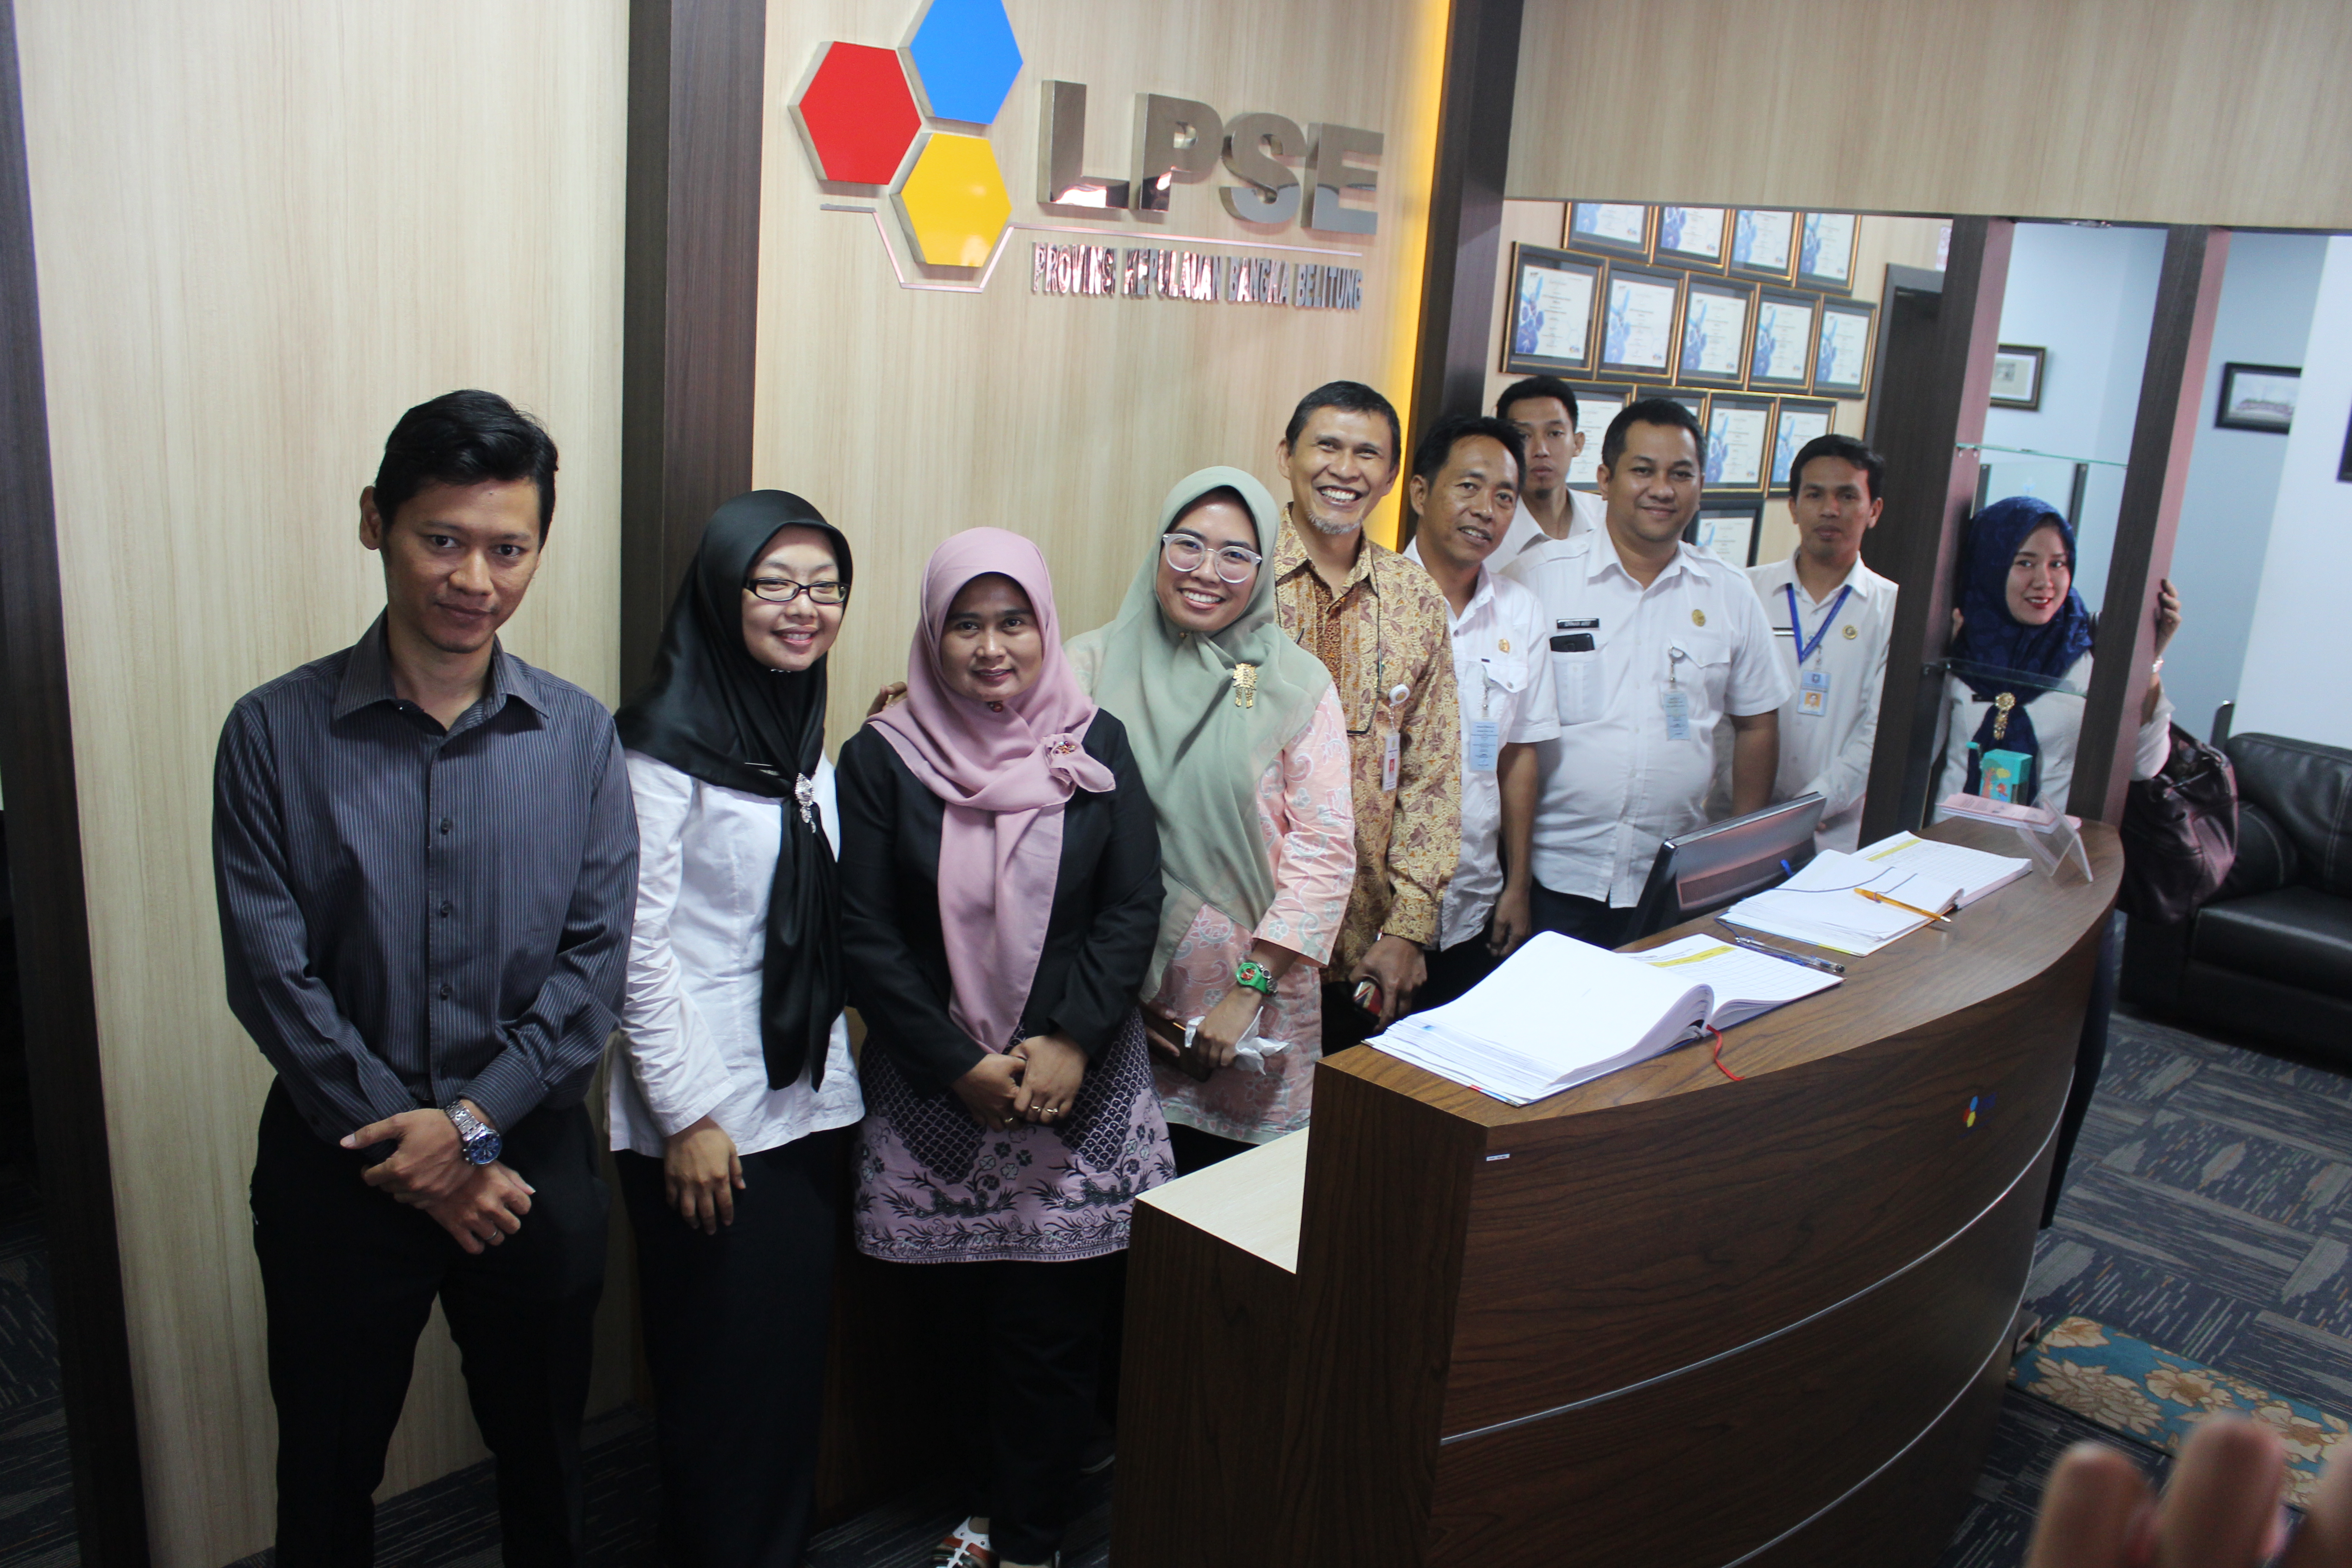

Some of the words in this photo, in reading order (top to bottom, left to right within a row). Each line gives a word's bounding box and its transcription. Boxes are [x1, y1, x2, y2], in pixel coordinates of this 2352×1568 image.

[1037, 80, 1384, 235] LPSE
[1031, 242, 1117, 294] PROVINSI
[1121, 248, 1222, 300] KEPULAUAN
[1225, 256, 1289, 304] BANGKA
[1294, 263, 1362, 309] BELITUNG
